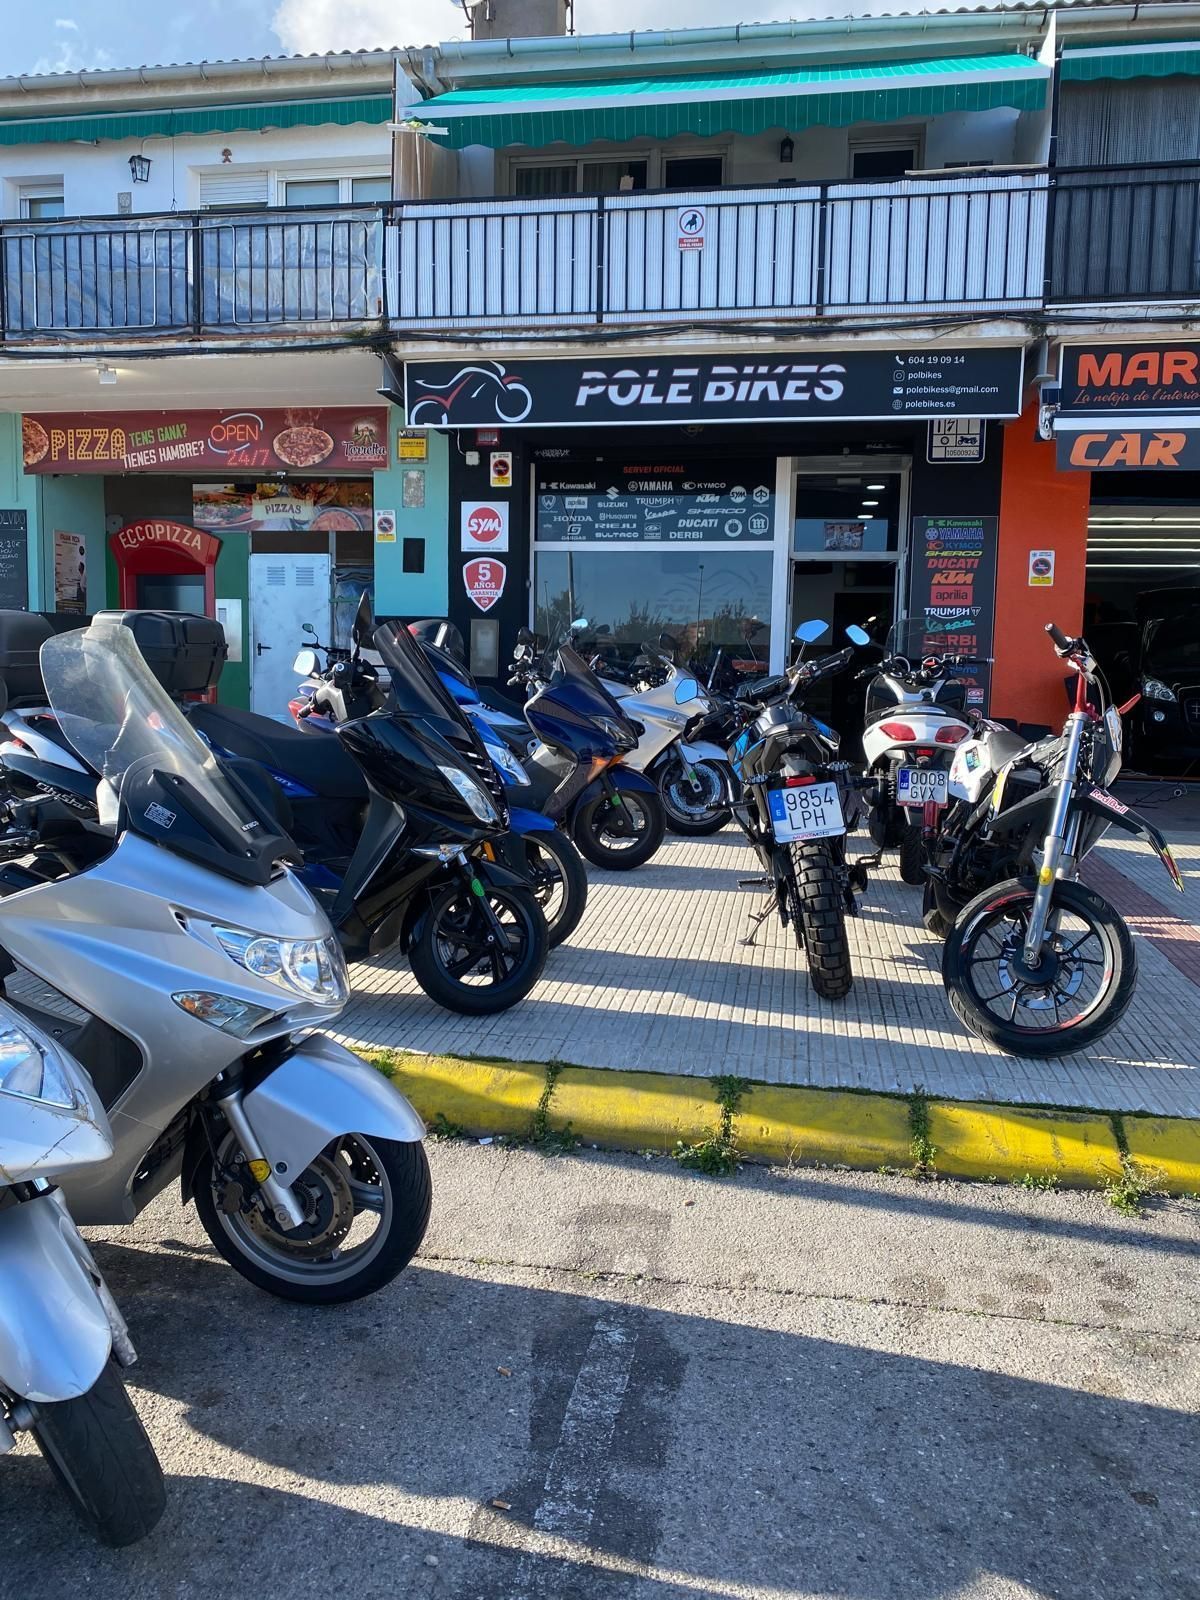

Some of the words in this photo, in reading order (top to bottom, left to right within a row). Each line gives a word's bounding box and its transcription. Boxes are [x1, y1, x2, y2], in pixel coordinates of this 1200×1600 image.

[908, 356, 925, 364] 604
[927, 356, 938, 364] 19
[940, 356, 951, 364] 09
[953, 356, 965, 364] 14
[908, 371, 942, 380] polbikes
[575, 367, 700, 407] POLE
[703, 363, 847, 402] BIKES
[906, 385, 999, 395] polebikess@gmail.com
[1072, 389, 1090, 404] La
[1094, 391, 1130, 407] neteja
[1133, 390, 1149, 401] de
[905, 400, 956, 409] polebikes.es
[128, 429, 155, 448] TENS
[157, 423, 188, 442] GANA?
[210, 424, 259, 442] OPEN
[50, 428, 127, 461] PIZZA
[1069, 432, 1187, 467] CAR
[122, 451, 157, 469] TIENES
[159, 440, 205, 462] HAMBRE?
[226, 448, 270, 466] 24/7
[623, 466, 652, 474] SERVEI
[653, 465, 685, 473] OFICIAL
[559, 482, 596, 490] Kawasaki
[638, 481, 673, 491] YAMAHA
[696, 494, 721, 503] KTM
[729, 490, 747, 499] SYM
[636, 497, 675, 506] TRIUMPH
[264, 503, 302, 514] PIZZAS
[644, 508, 678, 521] Vespa
[468, 518, 501, 535] SYM
[677, 519, 719, 528] DUCATI
[946, 519, 983, 527] Kawasaki
[118, 523, 201, 550] ECCOPIZZA
[669, 531, 703, 539] DERBI
[939, 528, 984, 540] YAMAHA
[927, 558, 979, 569] DUCATI
[478, 563, 491, 581] 5
[931, 570, 974, 585] KTM
[935, 589, 968, 601] aprilia
[924, 607, 970, 618] TRIUMPH
[924, 619, 976, 634] Vespa
[911, 770, 945, 787] 0008
[910, 786, 937, 800] GVX
[785, 787, 834, 812] 9854
[788, 807, 827, 831] LPH
